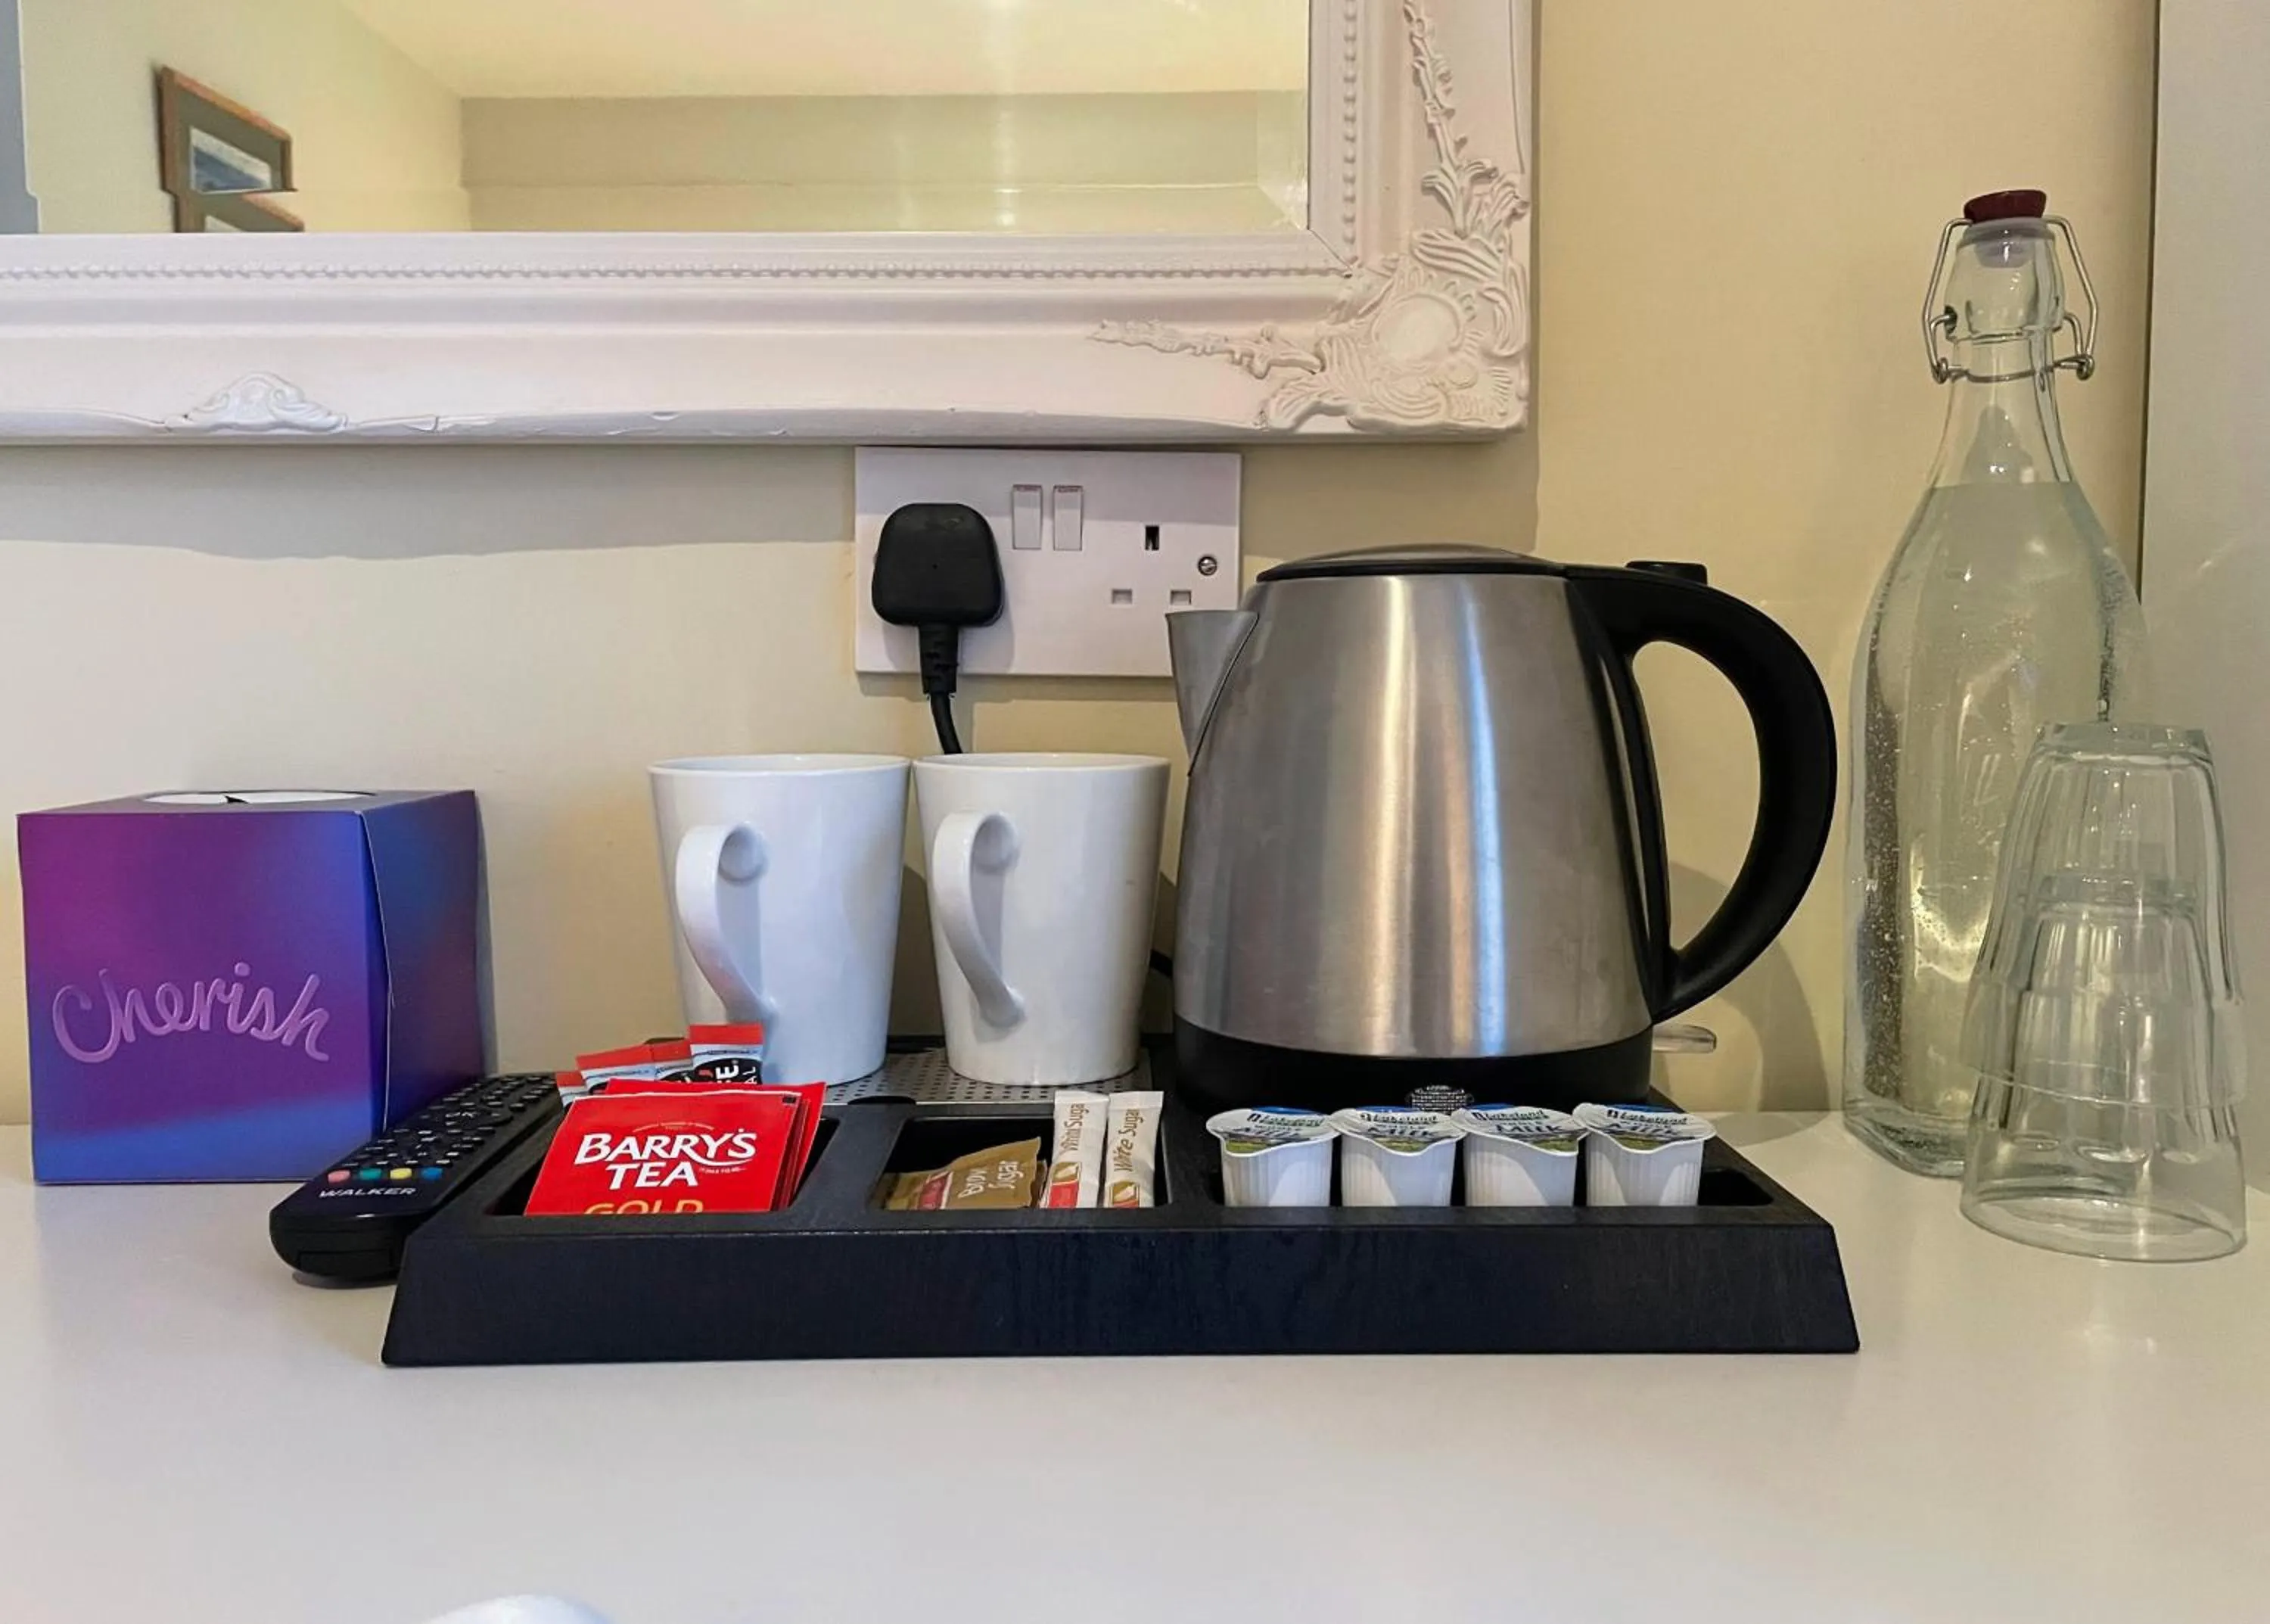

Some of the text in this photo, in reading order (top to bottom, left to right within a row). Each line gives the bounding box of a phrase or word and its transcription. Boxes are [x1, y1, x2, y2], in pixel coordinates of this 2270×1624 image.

[52, 962, 329, 1063] Cherish
[574, 1128, 757, 1166] BARRY'S
[605, 1160, 699, 1191] TEA
[319, 1187, 417, 1199] WALKER
